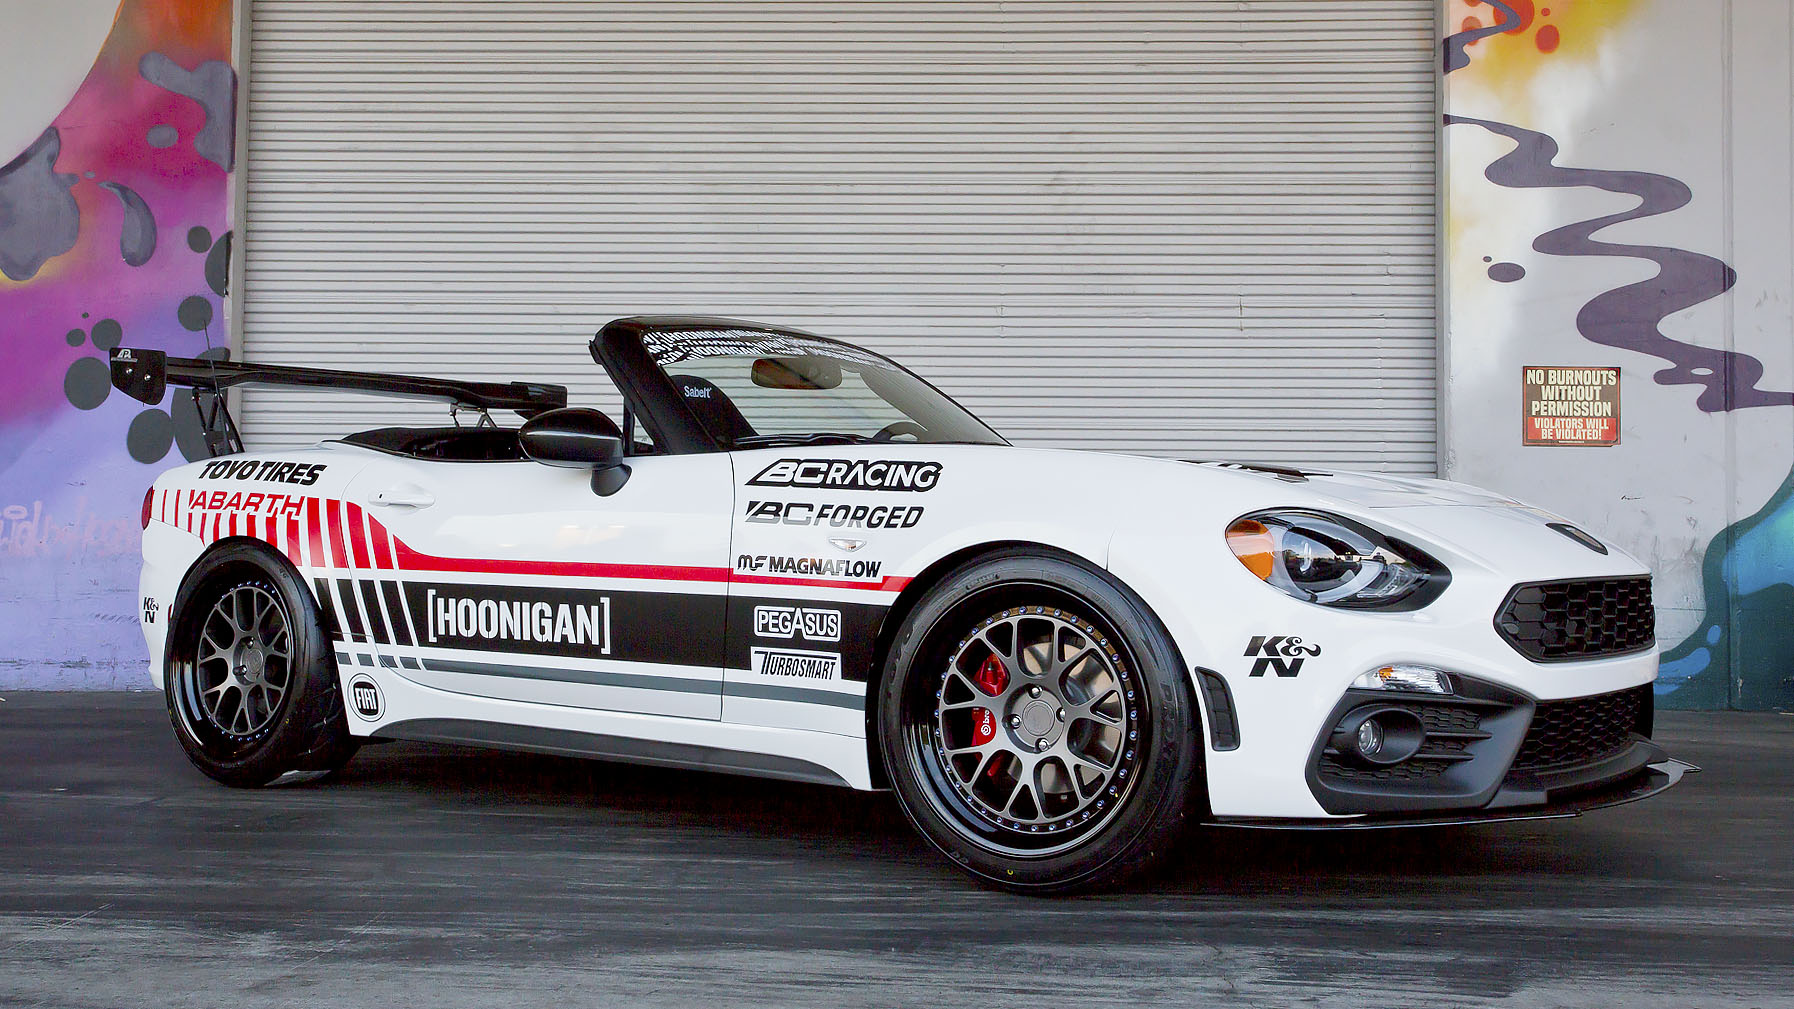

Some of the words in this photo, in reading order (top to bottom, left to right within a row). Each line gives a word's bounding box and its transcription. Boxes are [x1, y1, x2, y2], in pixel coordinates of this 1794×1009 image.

[1527, 369, 1545, 385] NO
[1548, 369, 1617, 386] BURNOUTS
[684, 385, 711, 399] Sabelt
[1541, 386, 1602, 401] WITHOUT
[1531, 401, 1612, 417] PERMISSION
[1534, 418, 1584, 429] VIOLATORS
[1586, 418, 1609, 430] WILL
[1541, 429, 1553, 440] BE
[1556, 429, 1602, 440] VIOLATED!
[826, 463, 938, 489] RACING
[189, 490, 306, 517] ABARTH
[814, 503, 925, 529] FORGED
[768, 556, 882, 578] MAGNAFLOW
[758, 607, 838, 637] PEGASUS
[753, 650, 838, 681] TURBOSMART
[354, 687, 378, 710] FIAT
